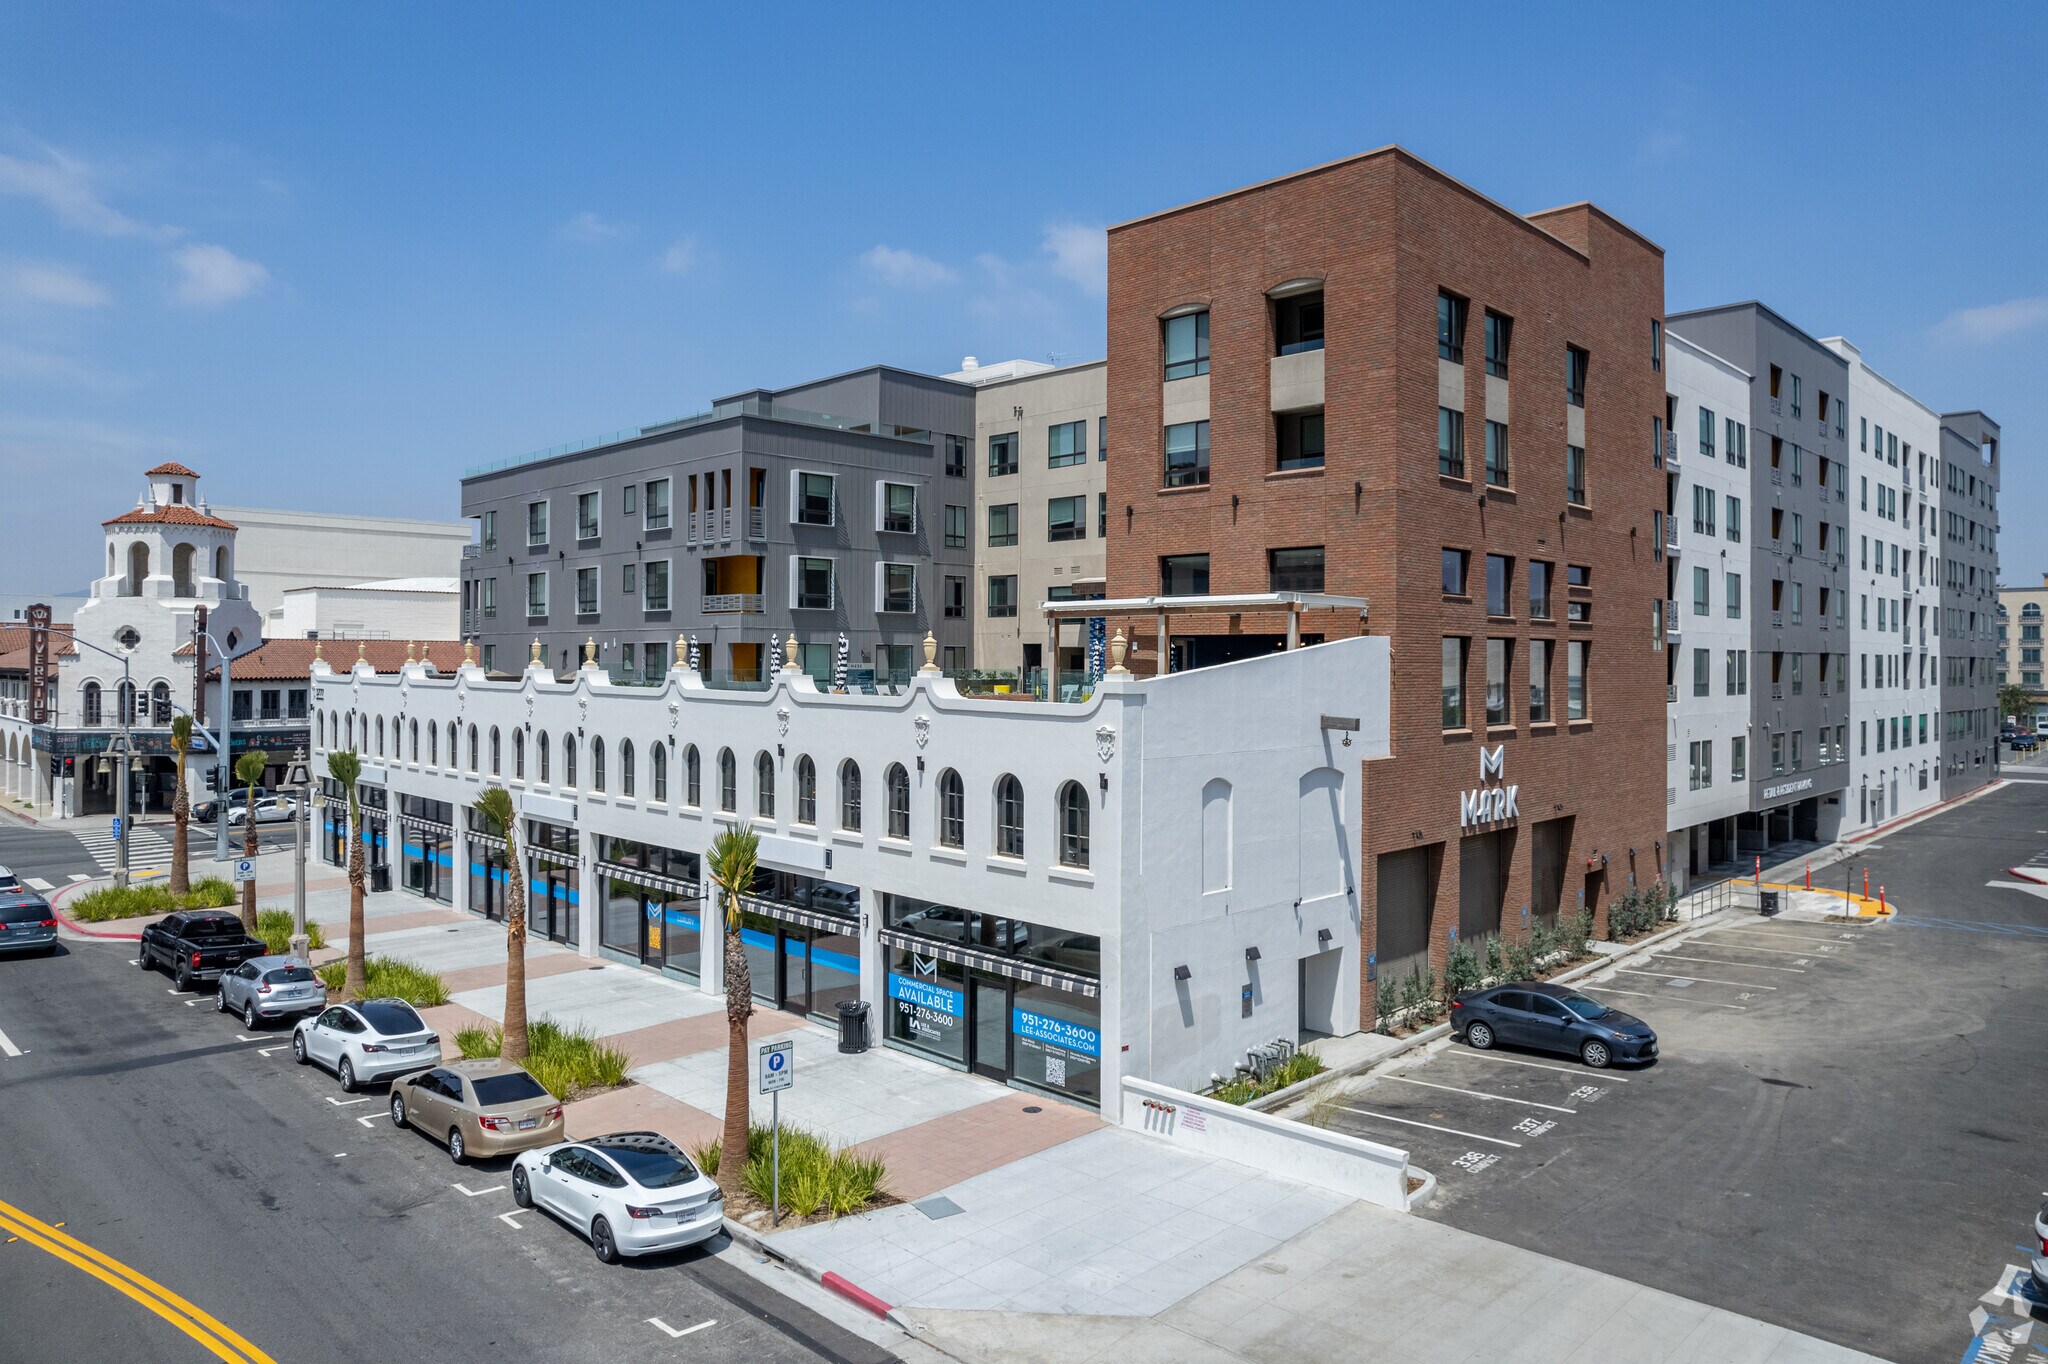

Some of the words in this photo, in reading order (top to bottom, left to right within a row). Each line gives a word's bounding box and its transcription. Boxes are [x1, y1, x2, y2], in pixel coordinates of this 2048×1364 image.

[33, 621, 45, 720] RIVERSIDE
[1461, 785, 1520, 827] MARK
[898, 977, 935, 994] COMMERCIAL
[936, 987, 954, 998] SPACE
[898, 987, 954, 1013] AVAILABLE
[899, 1002, 953, 1027] 951-276-3600
[1021, 1012, 1096, 1042] 951-276-3600
[761, 1047, 770, 1055] PAY
[770, 1043, 792, 1053] PARKING
[1021, 1025, 1096, 1053] LEE-ASSOCIATES.COM
[1512, 1117, 1542, 1133] 337
[1451, 1151, 1486, 1169] 336
